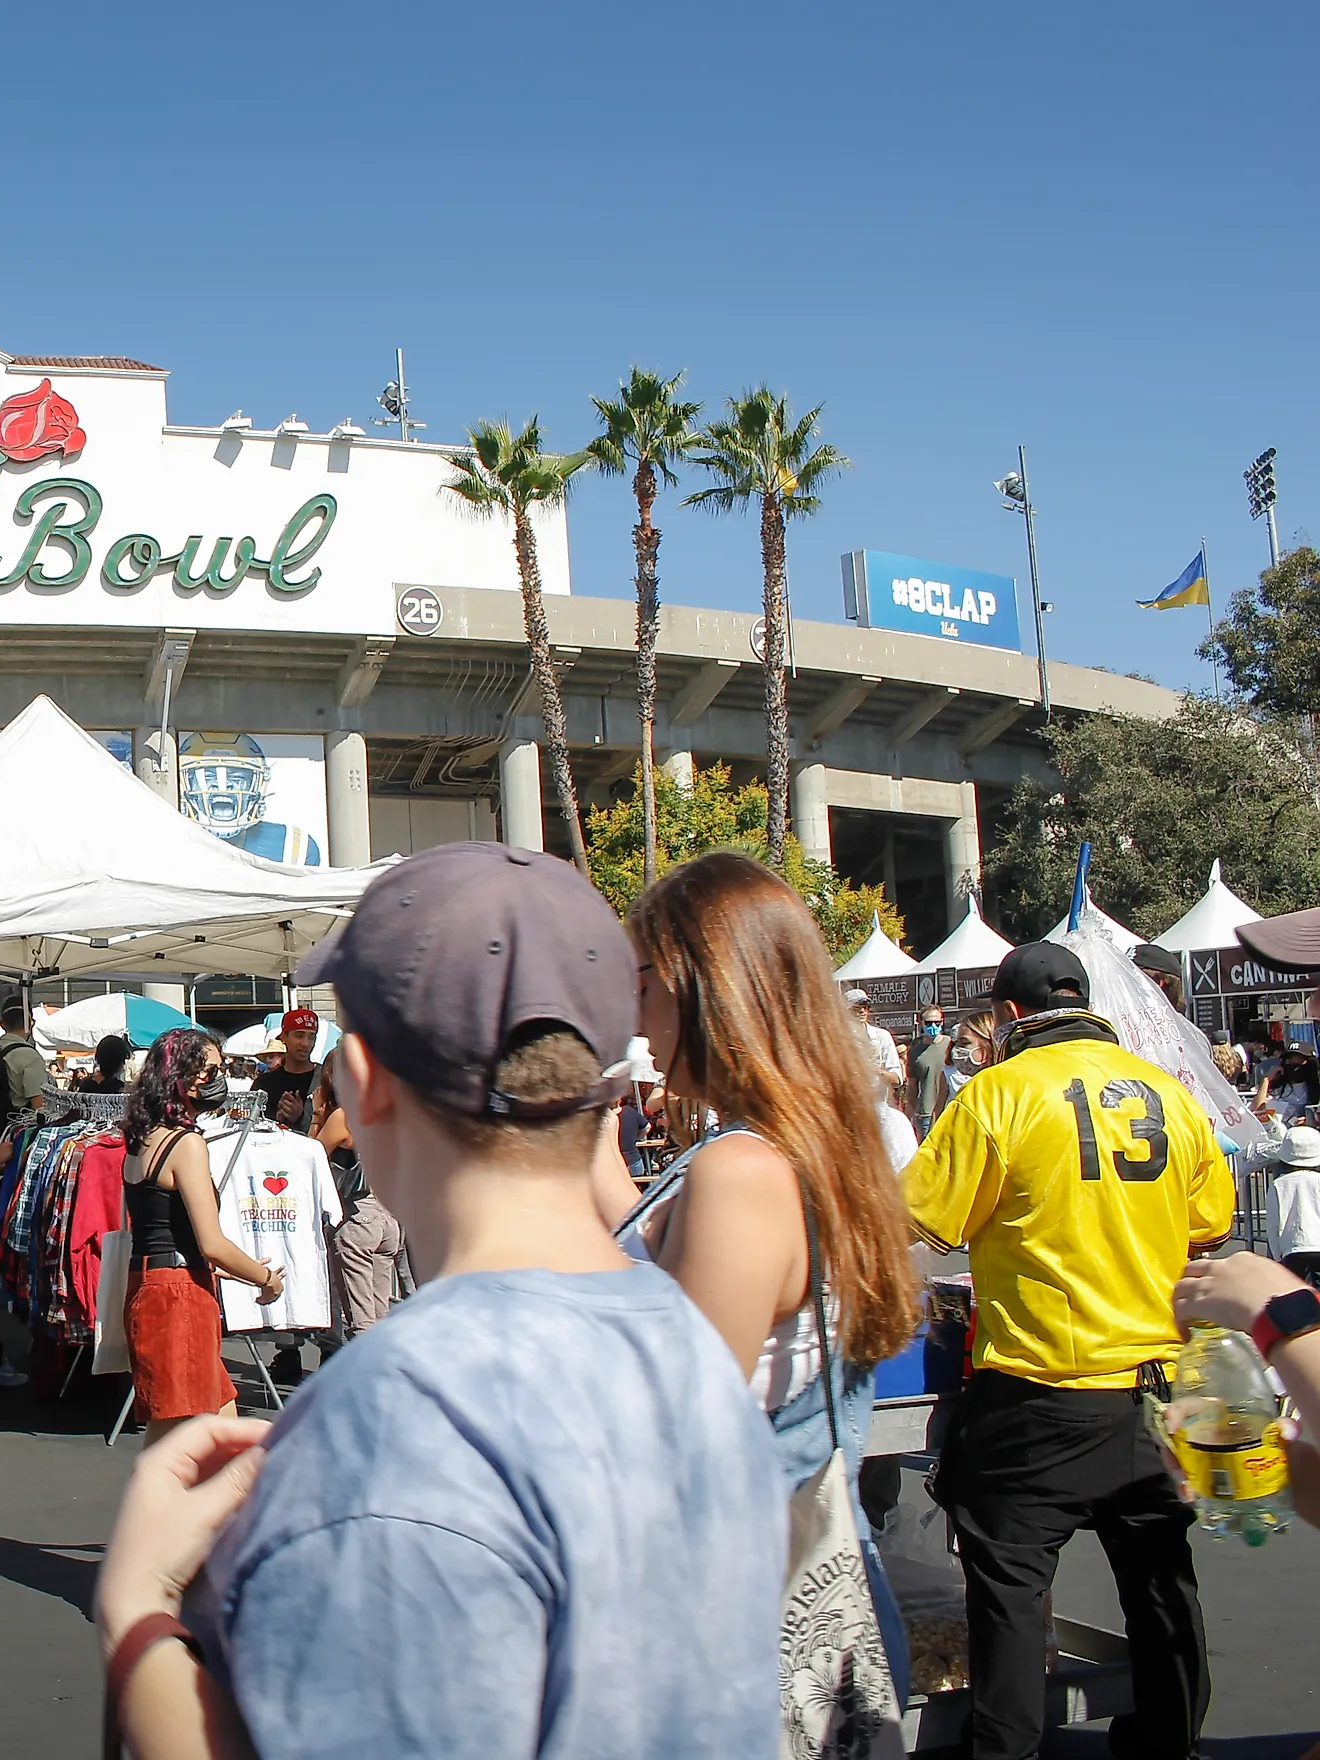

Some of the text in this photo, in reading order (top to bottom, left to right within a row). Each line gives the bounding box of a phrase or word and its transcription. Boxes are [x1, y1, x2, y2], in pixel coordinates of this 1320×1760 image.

[402, 597, 438, 624] 26
[891, 577, 997, 626] #8CLAP
[867, 981, 907, 994] TAMALE
[1062, 1078, 1169, 1182] 13
[247, 1175, 256, 1196] I
[240, 1208, 297, 1221] TEACHING
[242, 1220, 297, 1233] TEACHING
